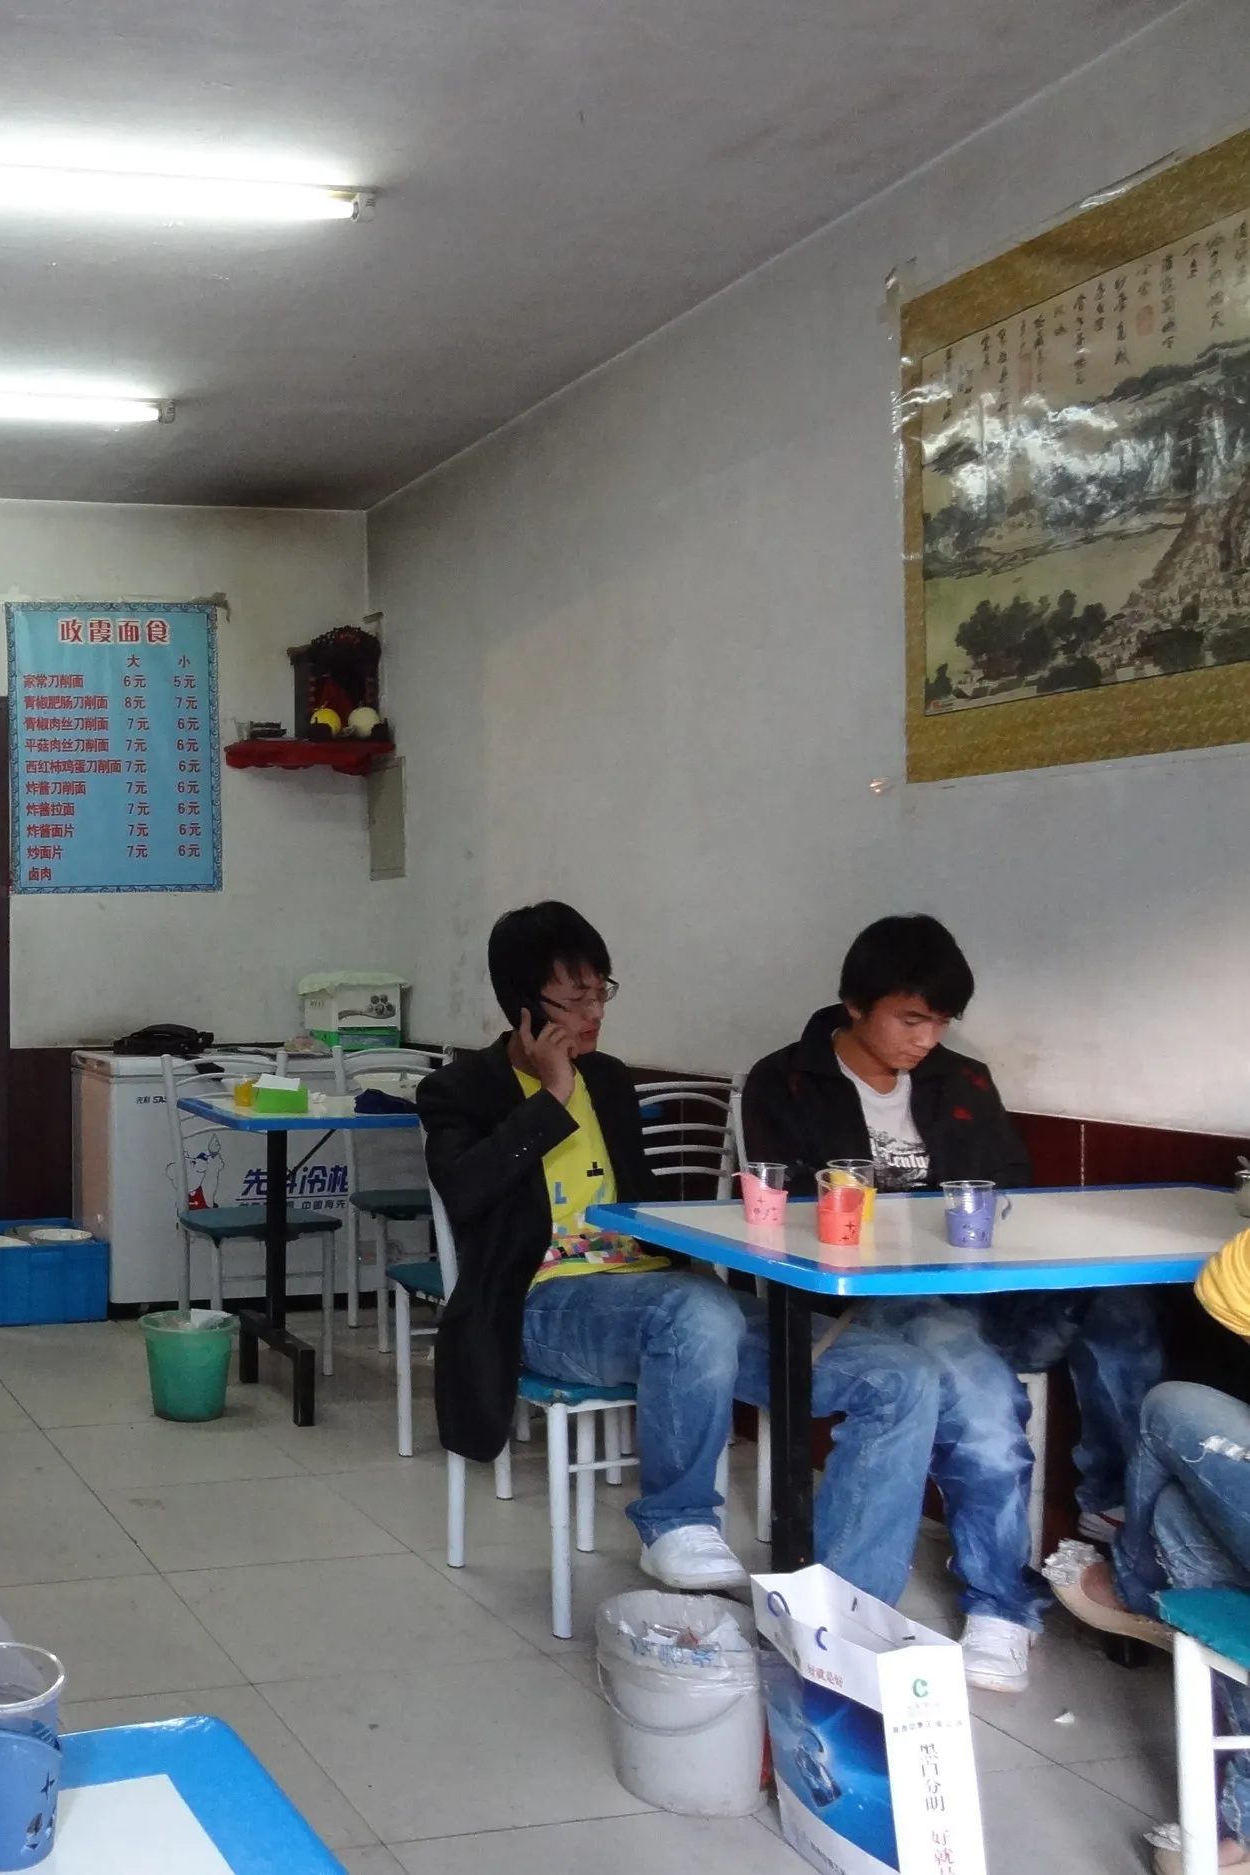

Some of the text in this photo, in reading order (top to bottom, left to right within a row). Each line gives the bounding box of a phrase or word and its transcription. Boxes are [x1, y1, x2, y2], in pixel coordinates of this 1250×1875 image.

[127, 655, 190, 668] 大 小
[23, 675, 196, 689] 家常刀削面 6元 5元
[23, 695, 198, 710] 青椒肥肠刀削面 8元 7元
[24, 716, 199, 732] 青椒肉丝刀削面 7元 6元
[25, 738, 198, 752] 平菇肉丝刀削面 7元 6元
[25, 759, 200, 774] 西红柿鸡蛋刀削面 7元 6元
[25, 780, 199, 796] 炸酱刀削面 7元 6元
[25, 802, 200, 817] 炸酱拉面 7元 6元
[26, 824, 201, 839] 炸酱面片 7元 6元
[27, 845, 200, 859] 炒面片 7元 6元
[28, 867, 52, 880] 卤肉
